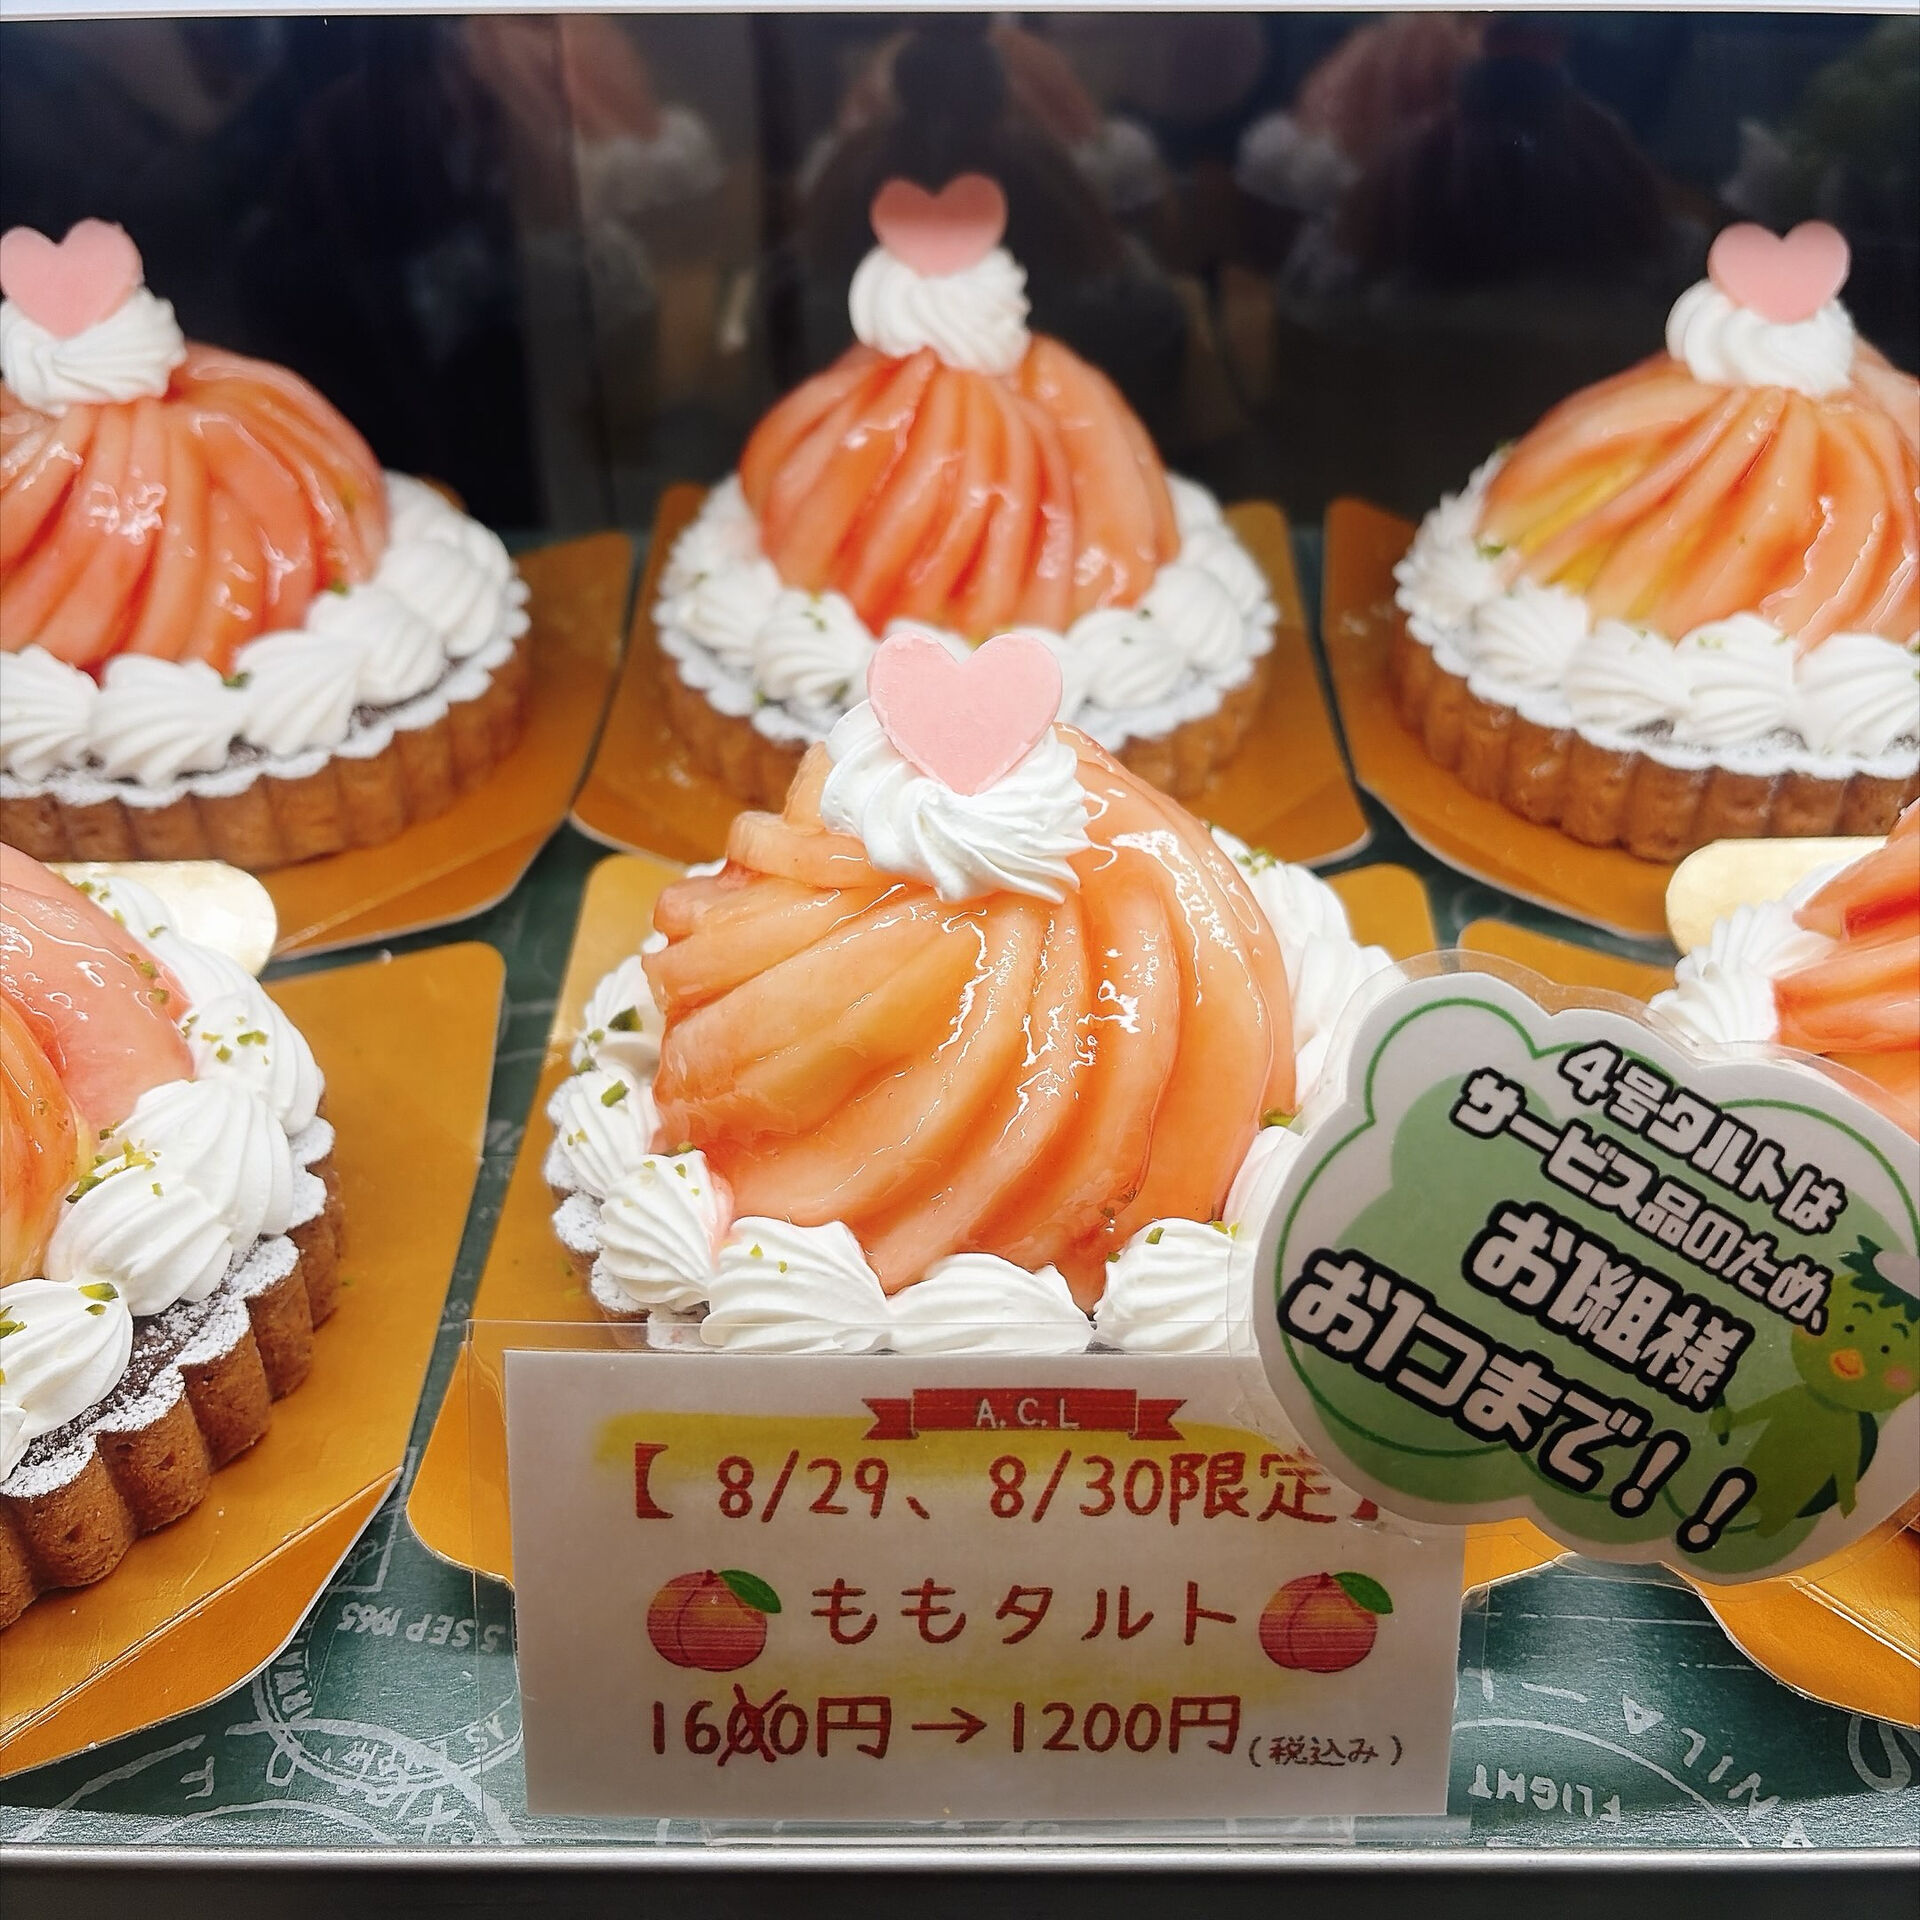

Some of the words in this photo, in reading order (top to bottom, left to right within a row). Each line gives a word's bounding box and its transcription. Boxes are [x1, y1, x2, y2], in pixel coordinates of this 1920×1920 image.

[1558, 1040, 1847, 1235] 4号タルトは
[1450, 1067, 1835, 1336] サービス品のため、
[1462, 1200, 1756, 1412] お1組様
[405, 1613, 478, 1648] SEP
[810, 1577, 1238, 1646] ももタルト
[1012, 1695, 1241, 1755] 1200円
[1248, 1734, 1403, 1768] (税込み)
[1466, 1763, 1622, 1824] FLIGHT
